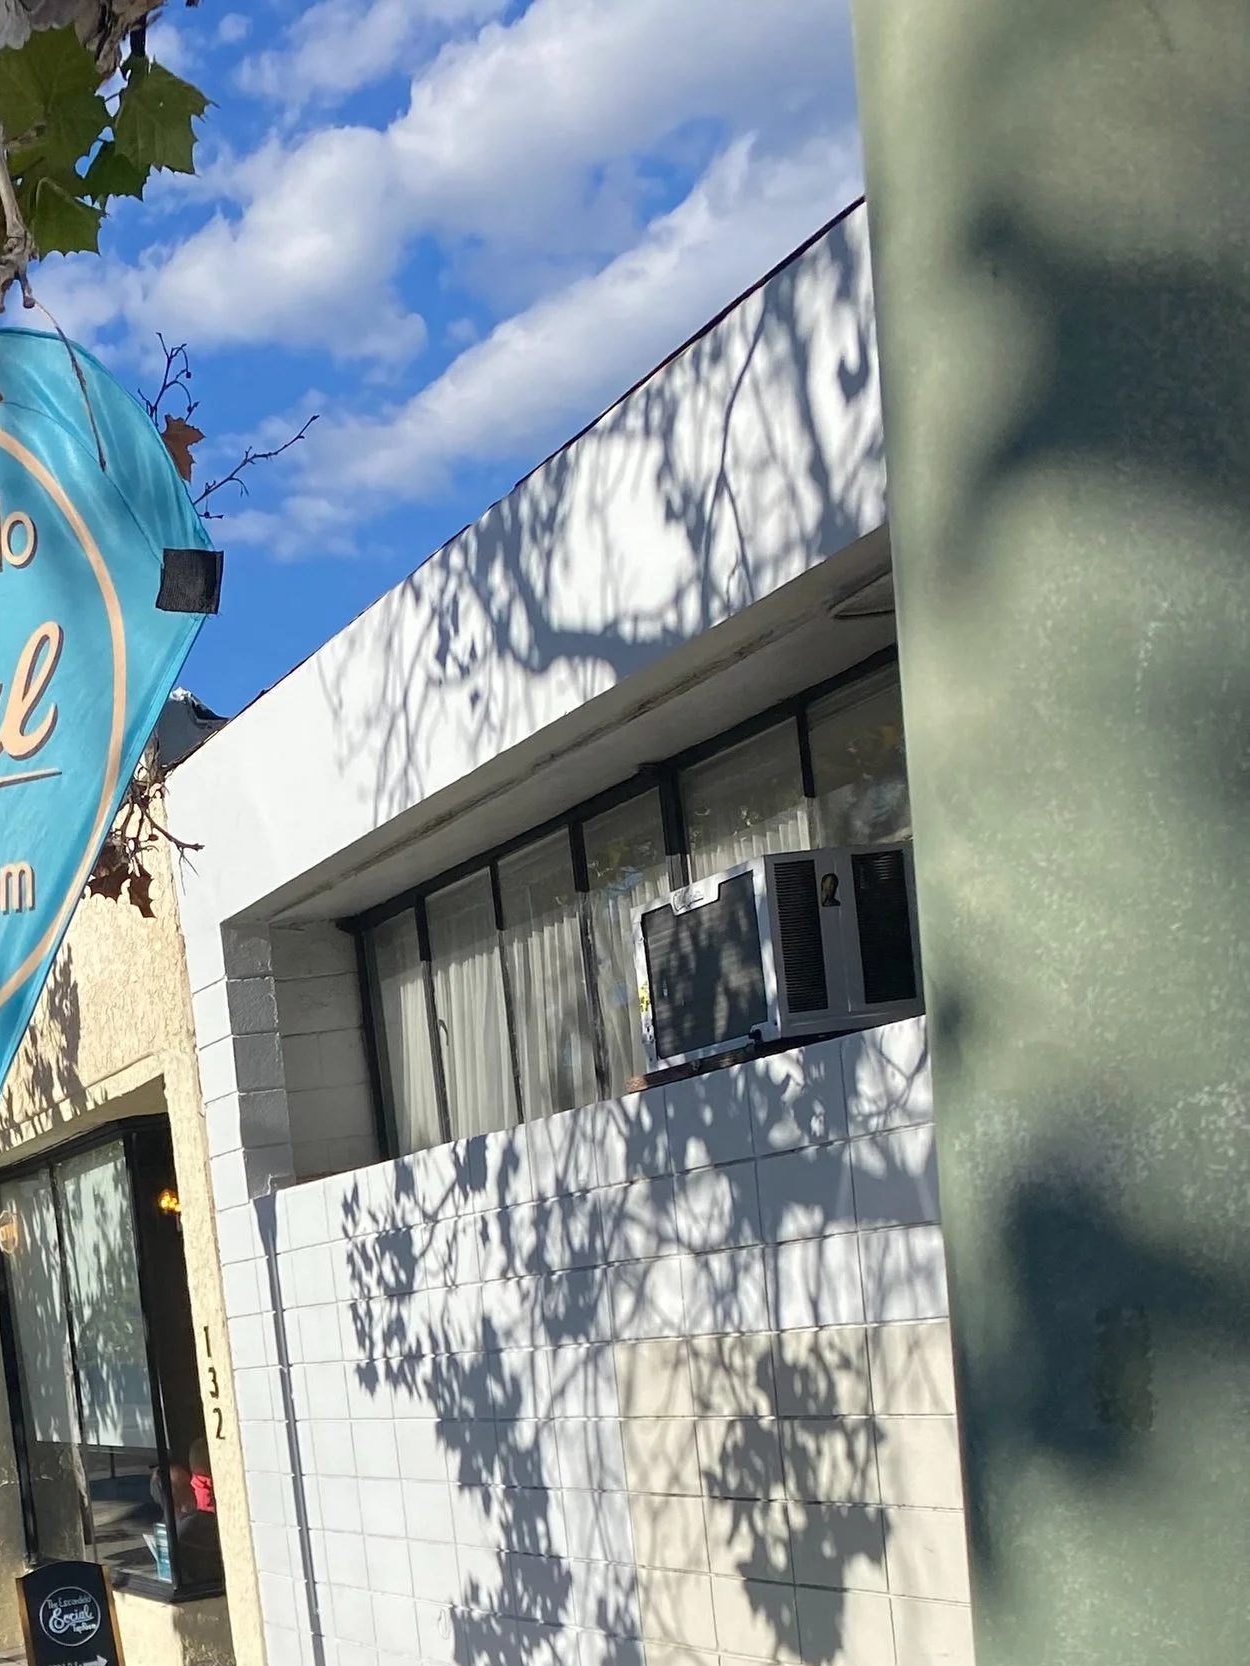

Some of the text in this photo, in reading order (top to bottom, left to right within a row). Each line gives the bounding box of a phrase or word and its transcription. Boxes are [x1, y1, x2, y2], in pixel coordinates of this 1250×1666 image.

[204, 1325, 225, 1440] 132
[47, 1599, 58, 1609] The
[49, 1604, 94, 1634] Social
